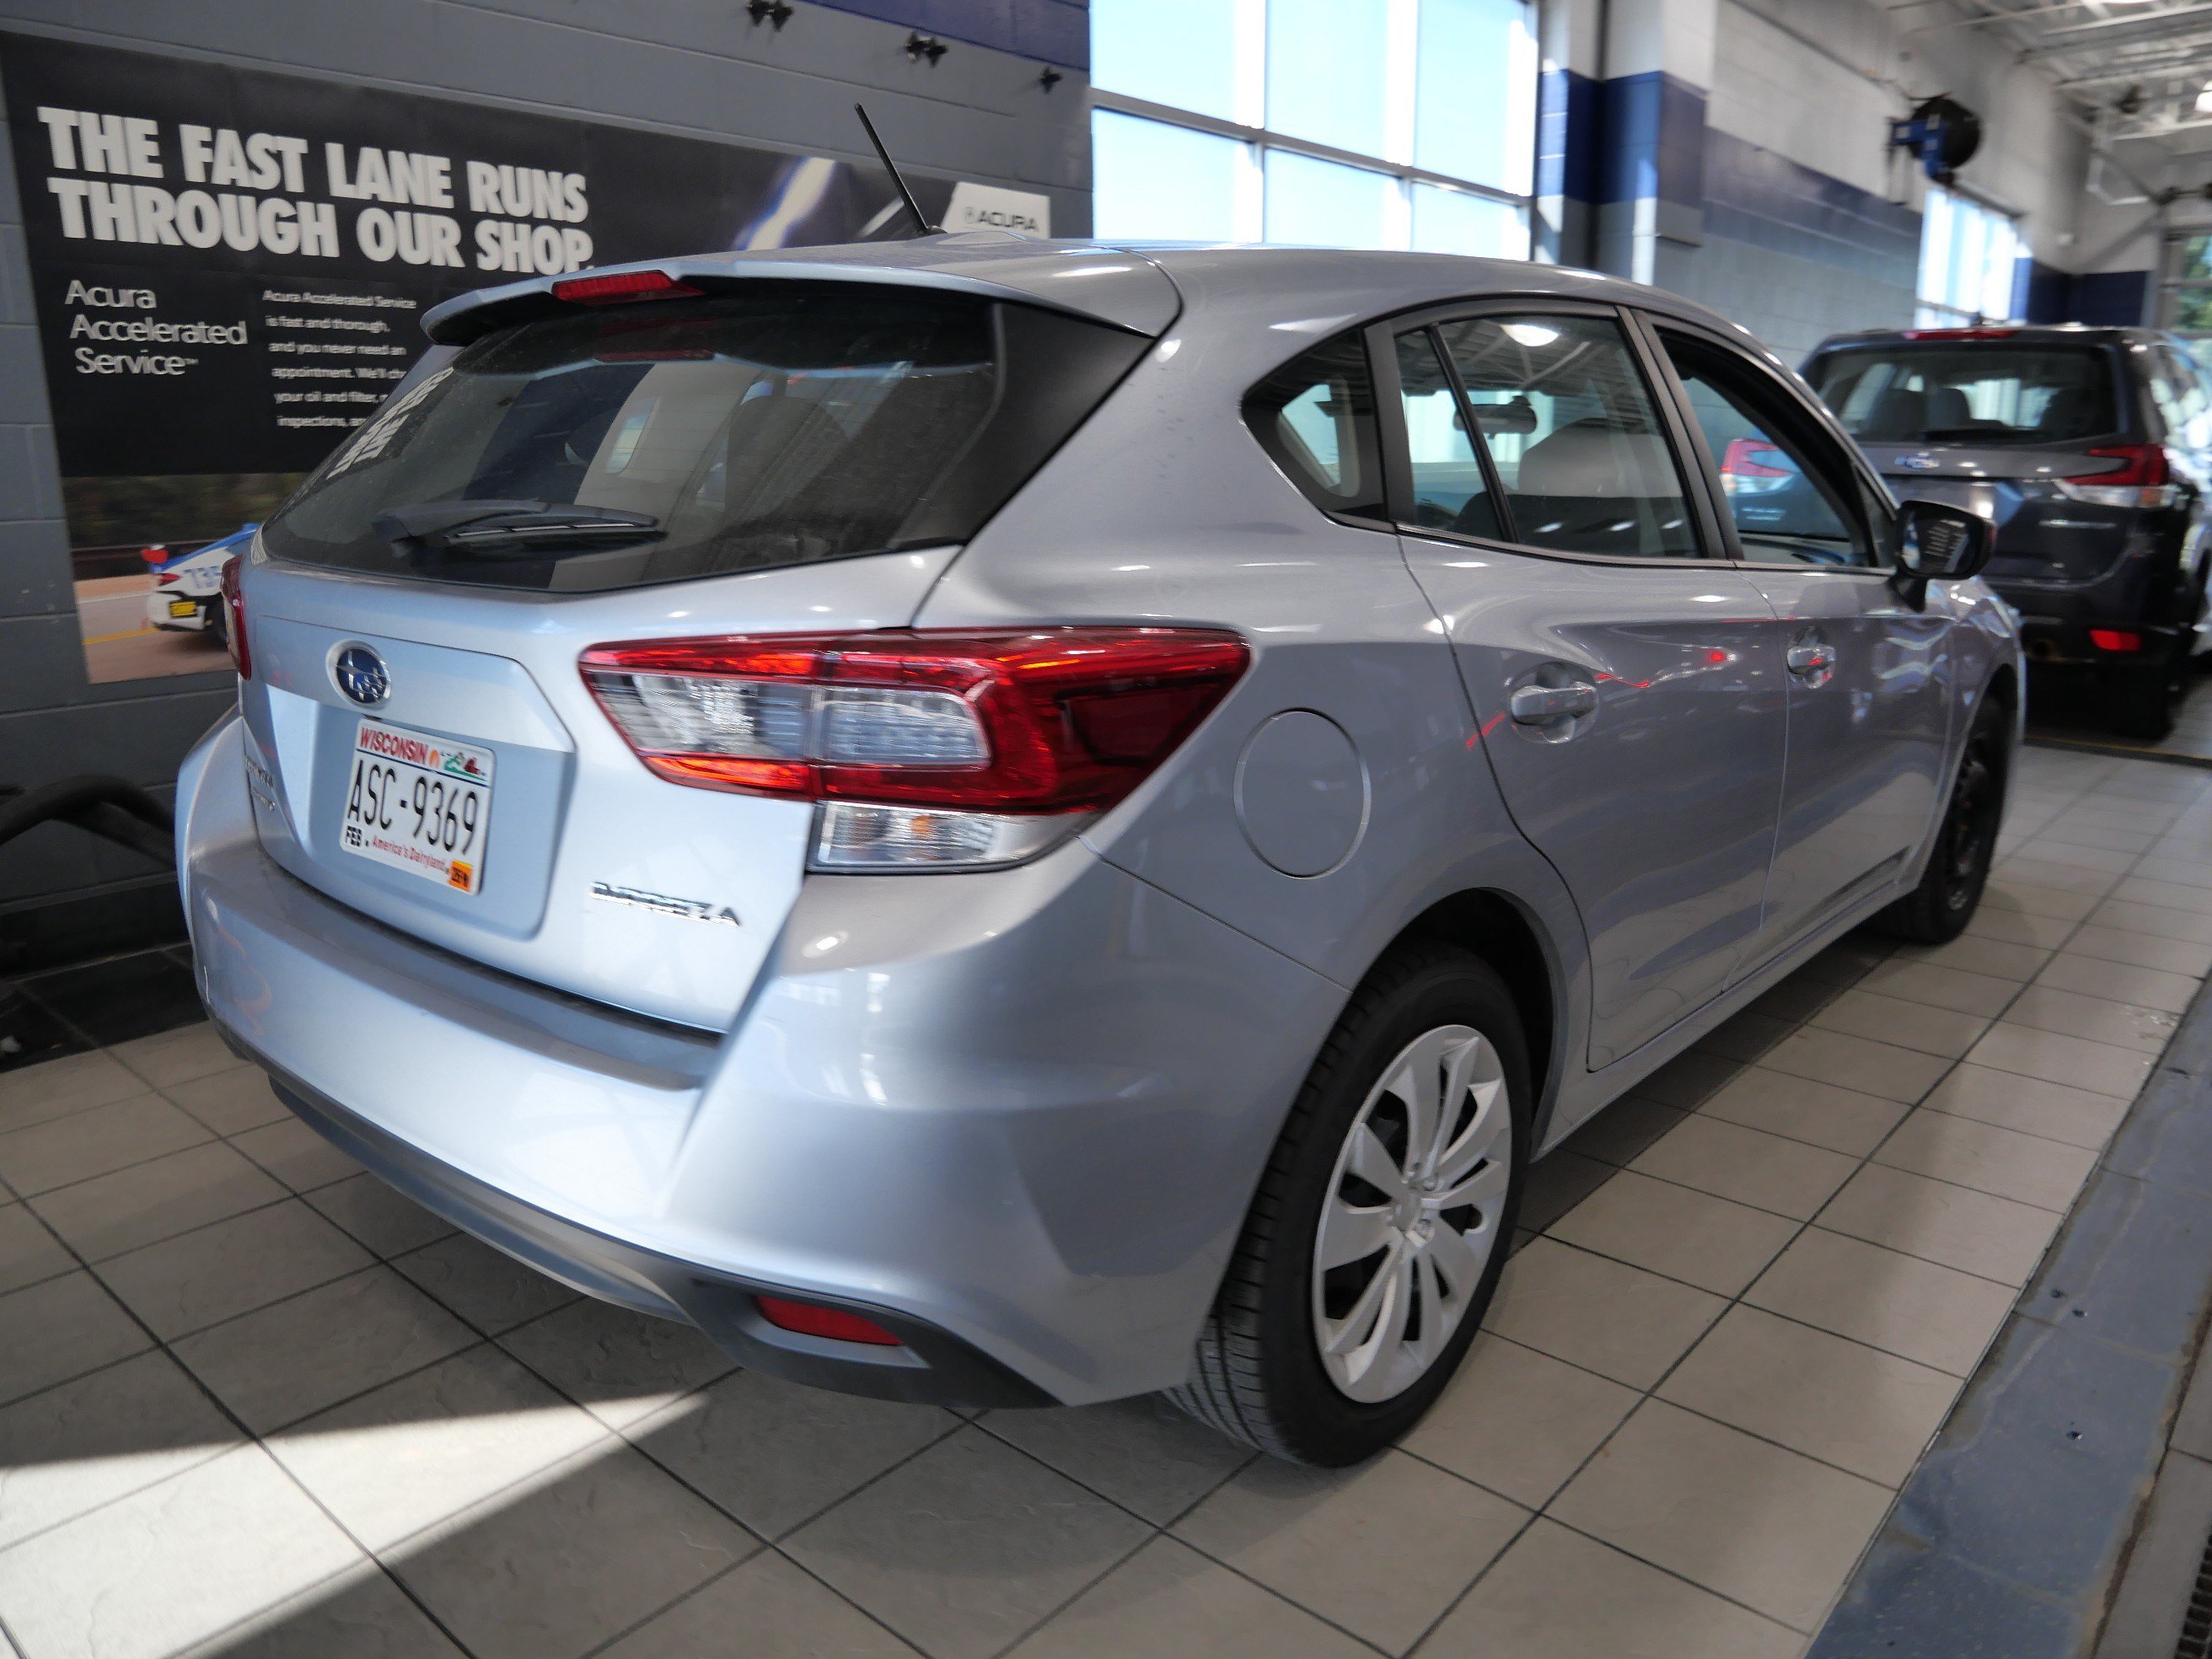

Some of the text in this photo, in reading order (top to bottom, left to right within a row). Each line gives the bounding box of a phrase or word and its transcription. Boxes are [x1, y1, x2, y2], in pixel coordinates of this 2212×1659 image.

[37, 107, 588, 223] THE FAST LANE RUNS
[46, 177, 339, 257] THROUGH
[357, 207, 465, 268] OUR
[978, 211, 1038, 230] ACURA
[64, 280, 157, 309] Acura
[69, 314, 248, 345] Accelerated
[360, 727, 429, 765] WISCONSIN
[348, 759, 478, 856] ASC-9369
